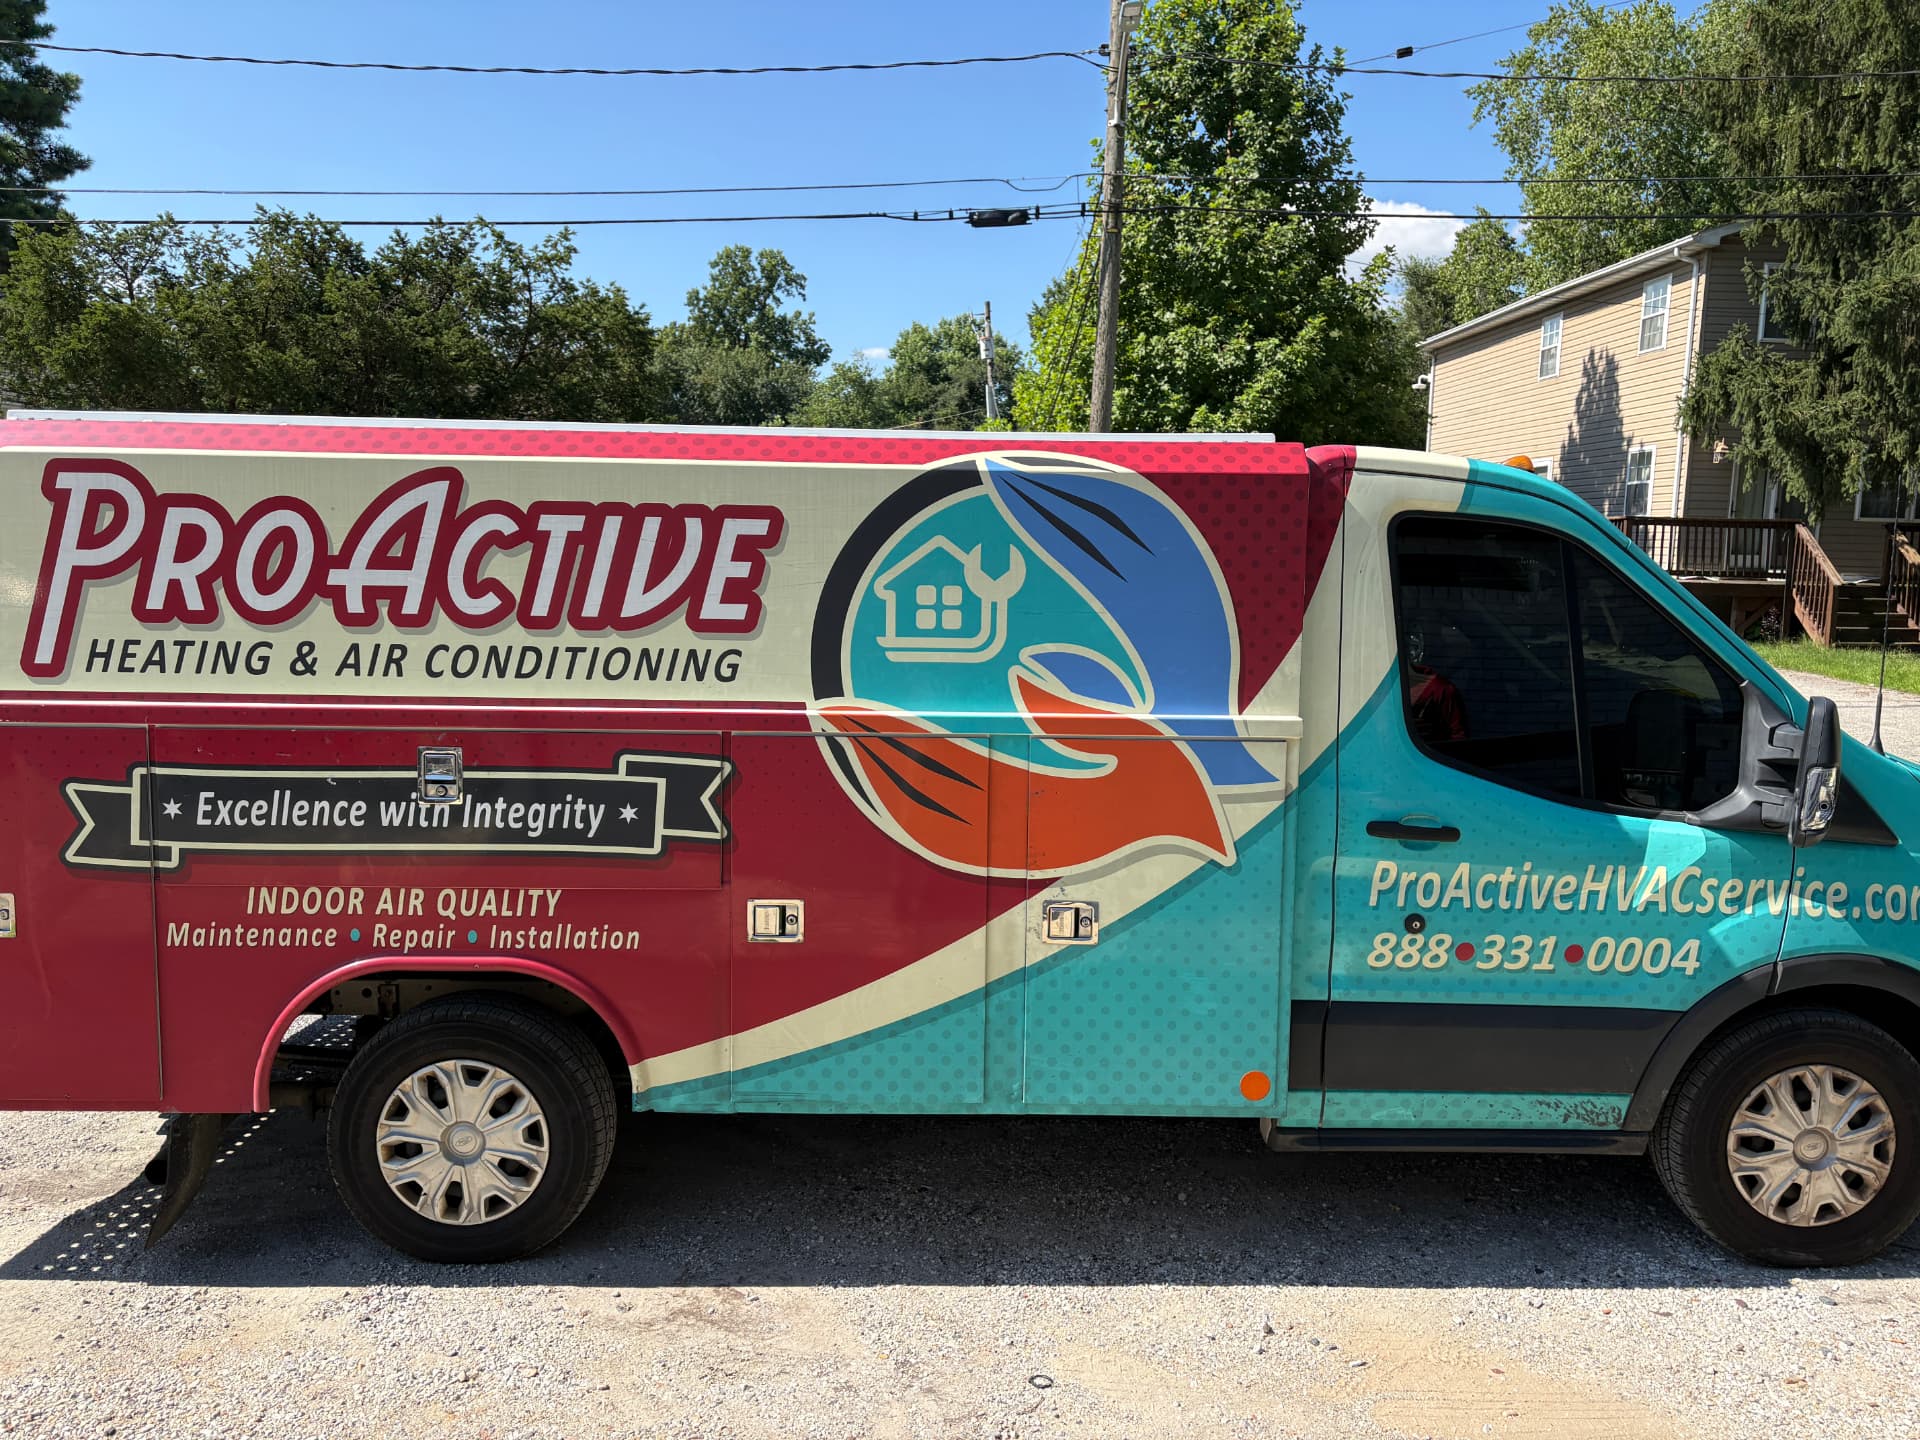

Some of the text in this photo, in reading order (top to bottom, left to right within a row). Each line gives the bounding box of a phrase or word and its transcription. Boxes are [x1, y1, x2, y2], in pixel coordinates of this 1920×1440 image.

[33, 471, 772, 666] PROACTIVE
[85, 638, 743, 683] HEATING & AIR CONDITIONING
[196, 790, 606, 838] Excellence with Integrity
[246, 886, 563, 921] INDOOR AIR QUALITY
[166, 921, 641, 954] Maintenance Repair Installation
